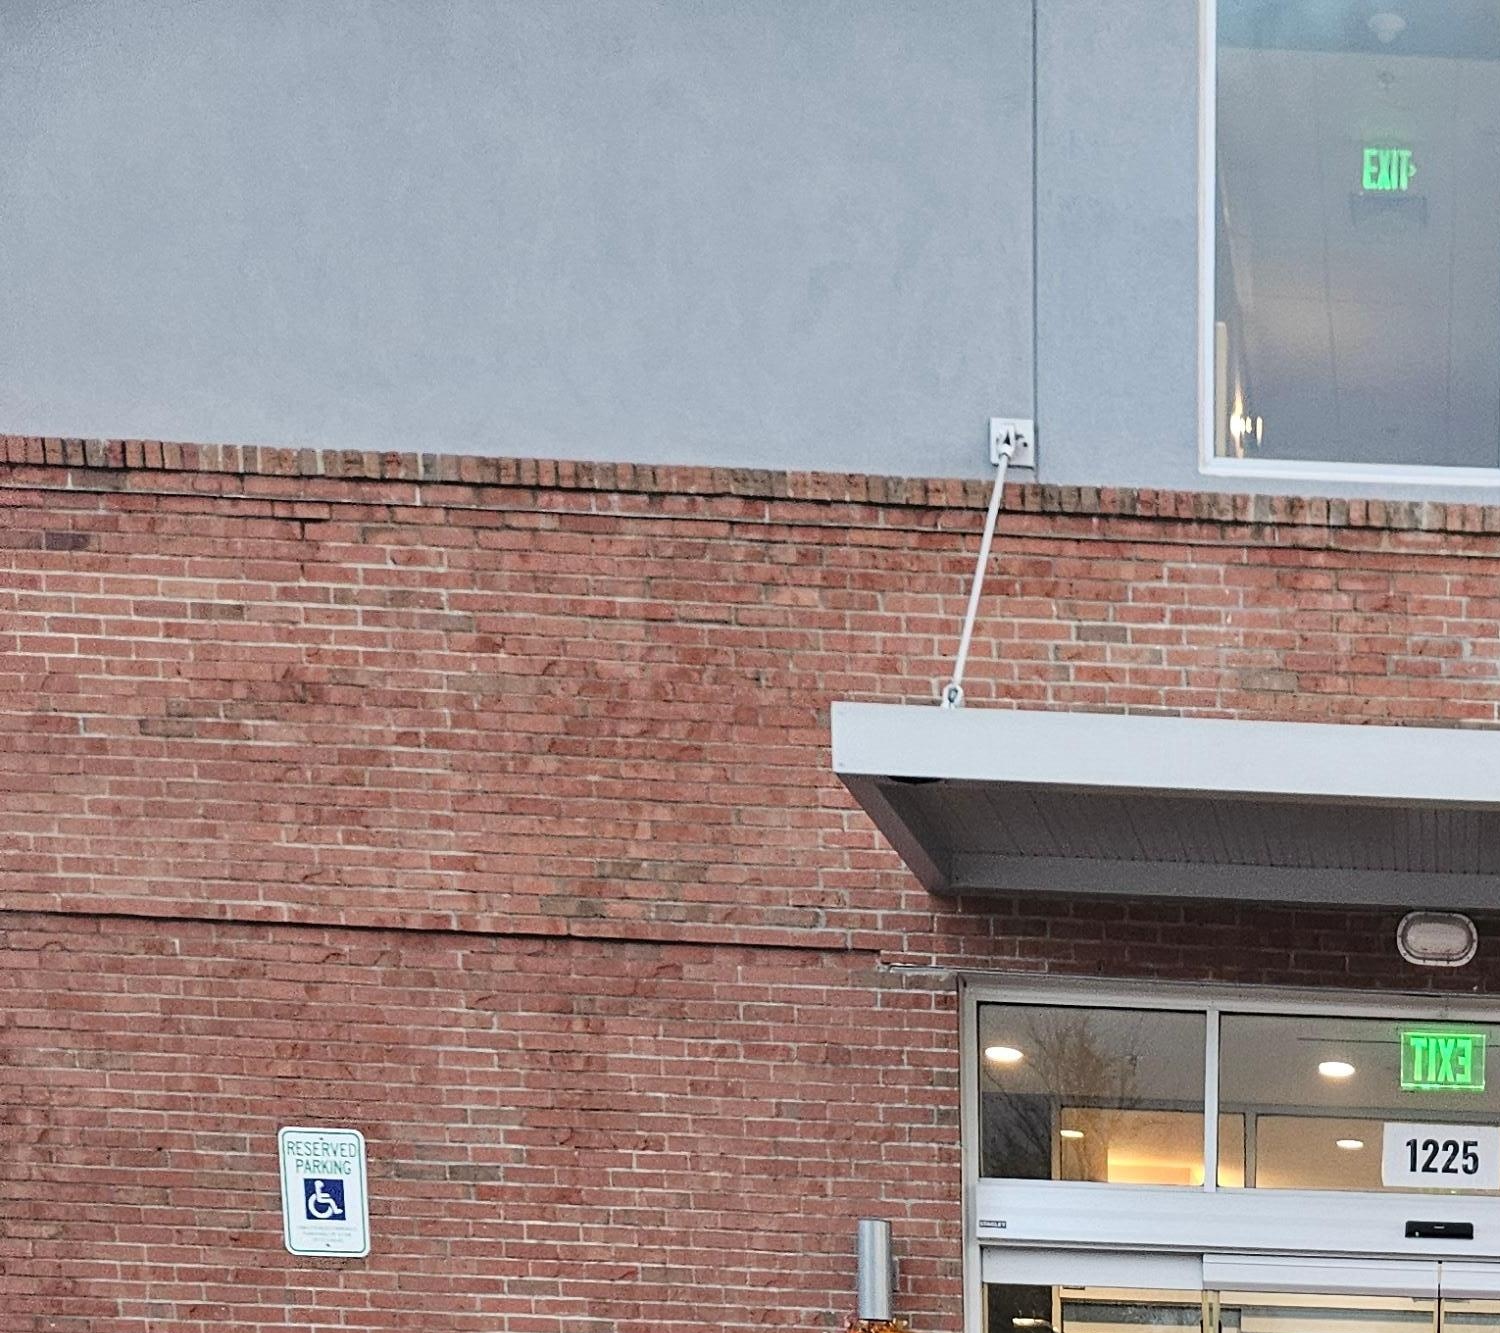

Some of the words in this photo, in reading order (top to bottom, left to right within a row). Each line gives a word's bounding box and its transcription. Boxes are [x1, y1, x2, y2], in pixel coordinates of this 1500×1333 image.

[1363, 148, 1412, 191] EXIT
[286, 1140, 357, 1158] RESERVED
[1405, 1138, 1479, 1175] 1225
[295, 1158, 352, 1175] PARKING
